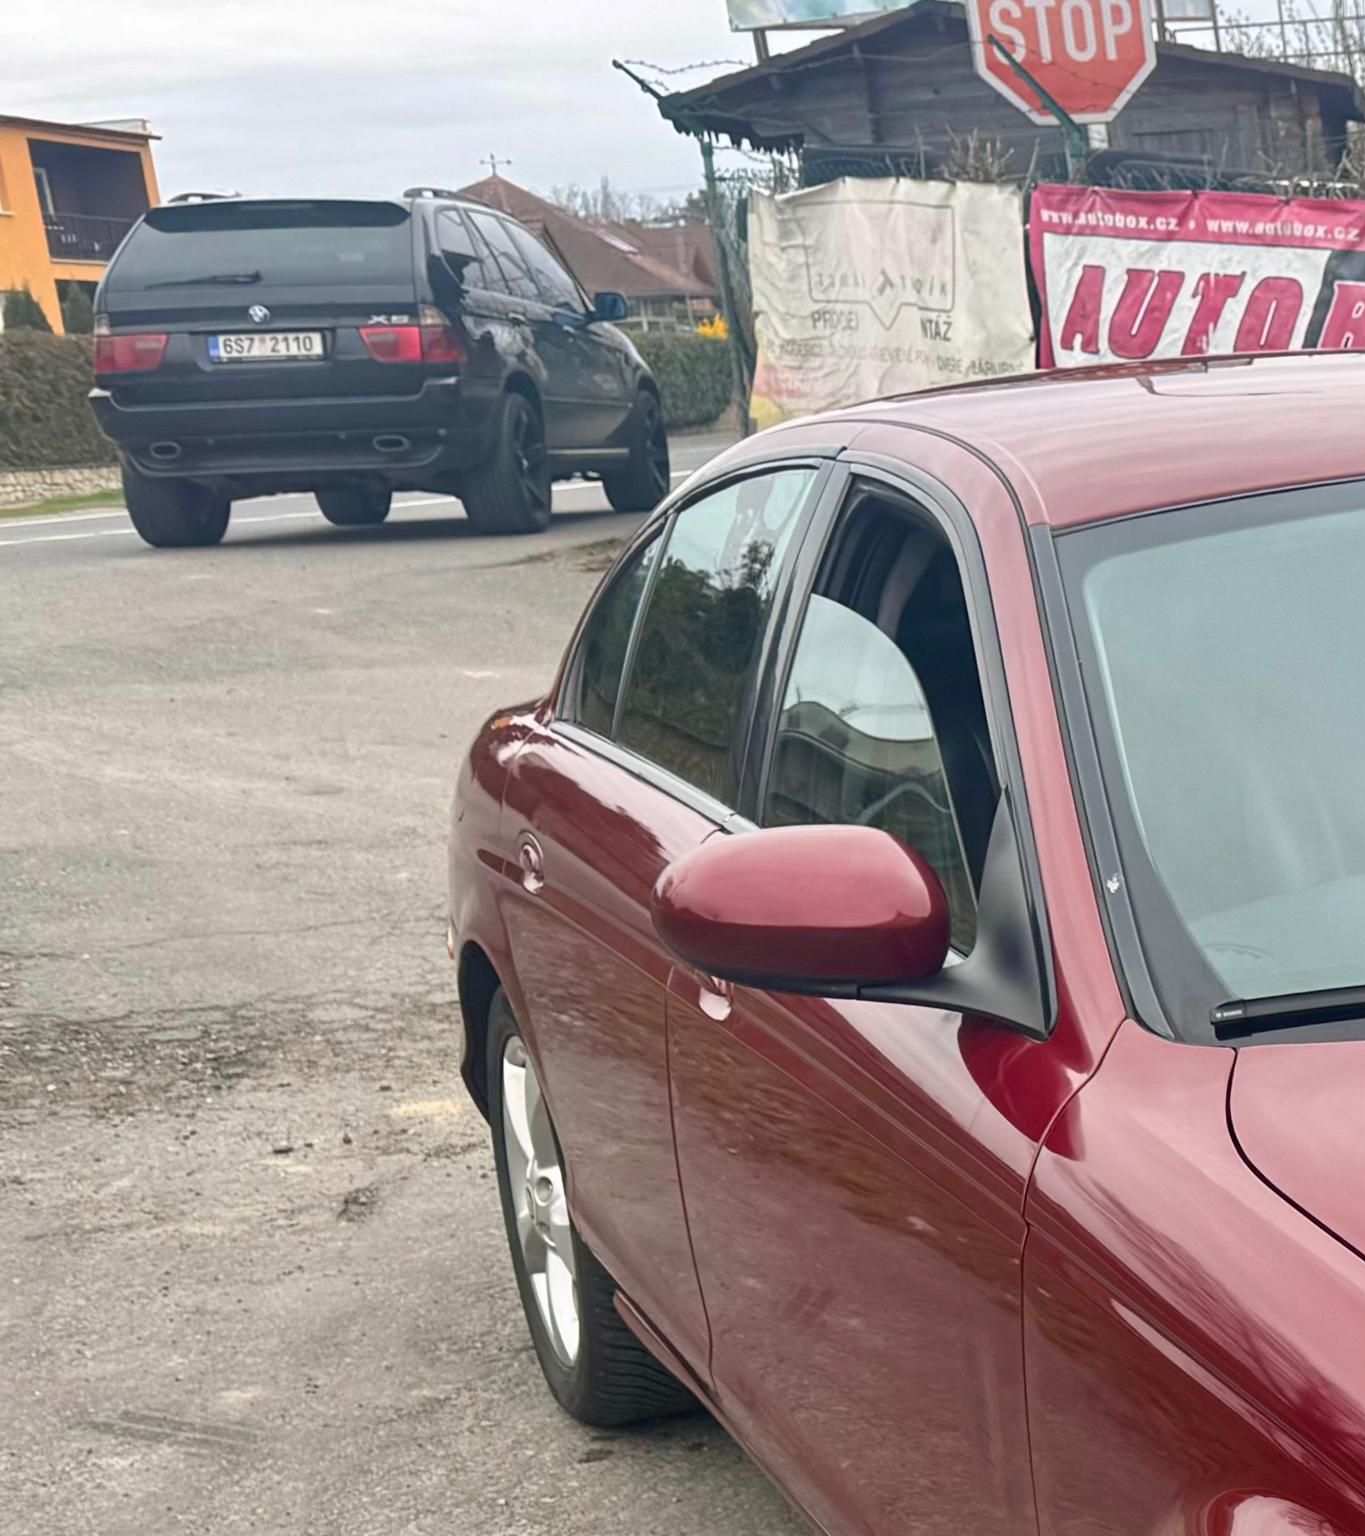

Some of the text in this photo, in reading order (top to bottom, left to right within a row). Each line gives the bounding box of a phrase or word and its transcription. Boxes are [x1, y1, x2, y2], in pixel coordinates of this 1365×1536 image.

[989, 0, 1133, 65] STOP
[1040, 208, 1179, 231] www.autobox.cz
[1206, 218, 1360, 241] www.autobox.cz
[222, 335, 314, 355] 6S7 2110
